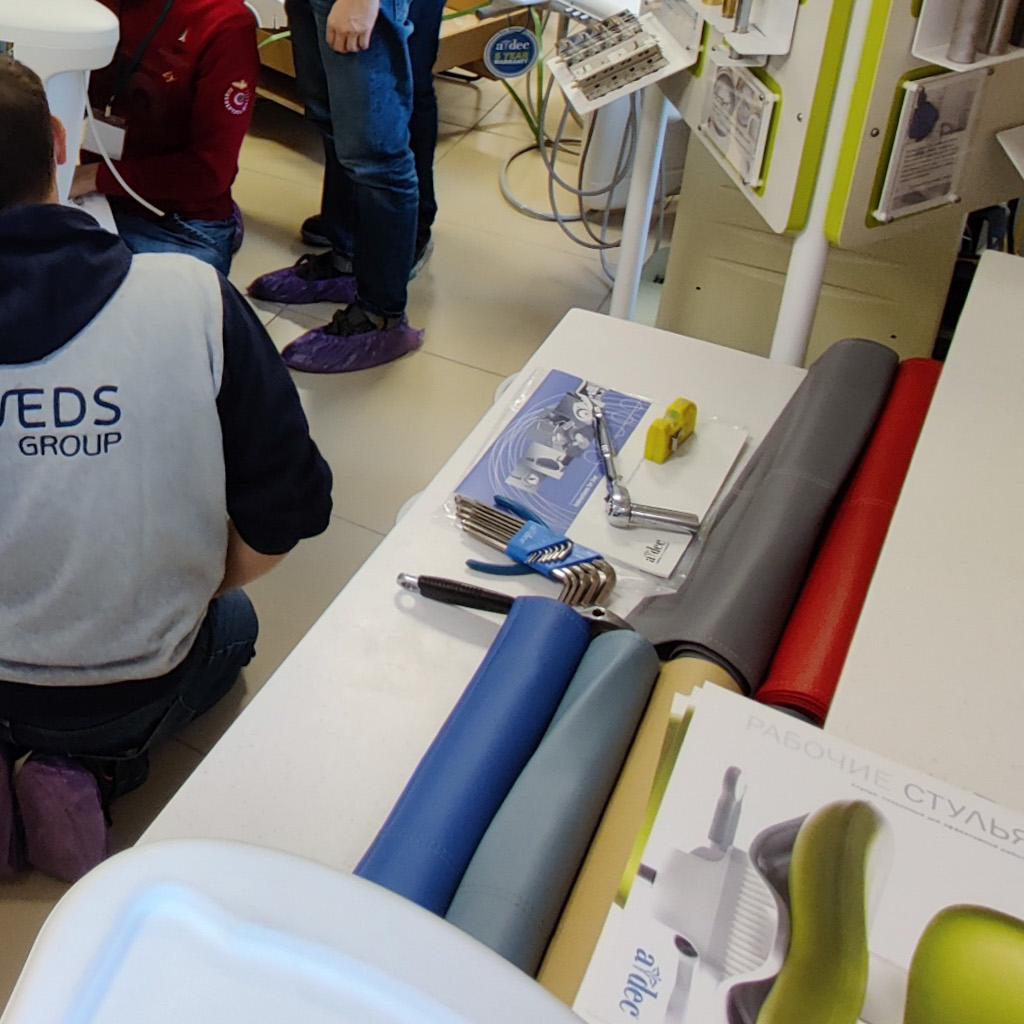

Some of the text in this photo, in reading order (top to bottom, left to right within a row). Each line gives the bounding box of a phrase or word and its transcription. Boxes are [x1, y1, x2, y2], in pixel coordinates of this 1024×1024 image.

[18, 432, 122, 456] GROUP
[744, 714, 1024, 845] РАБОЧИЕ СТУЛЬЯ
